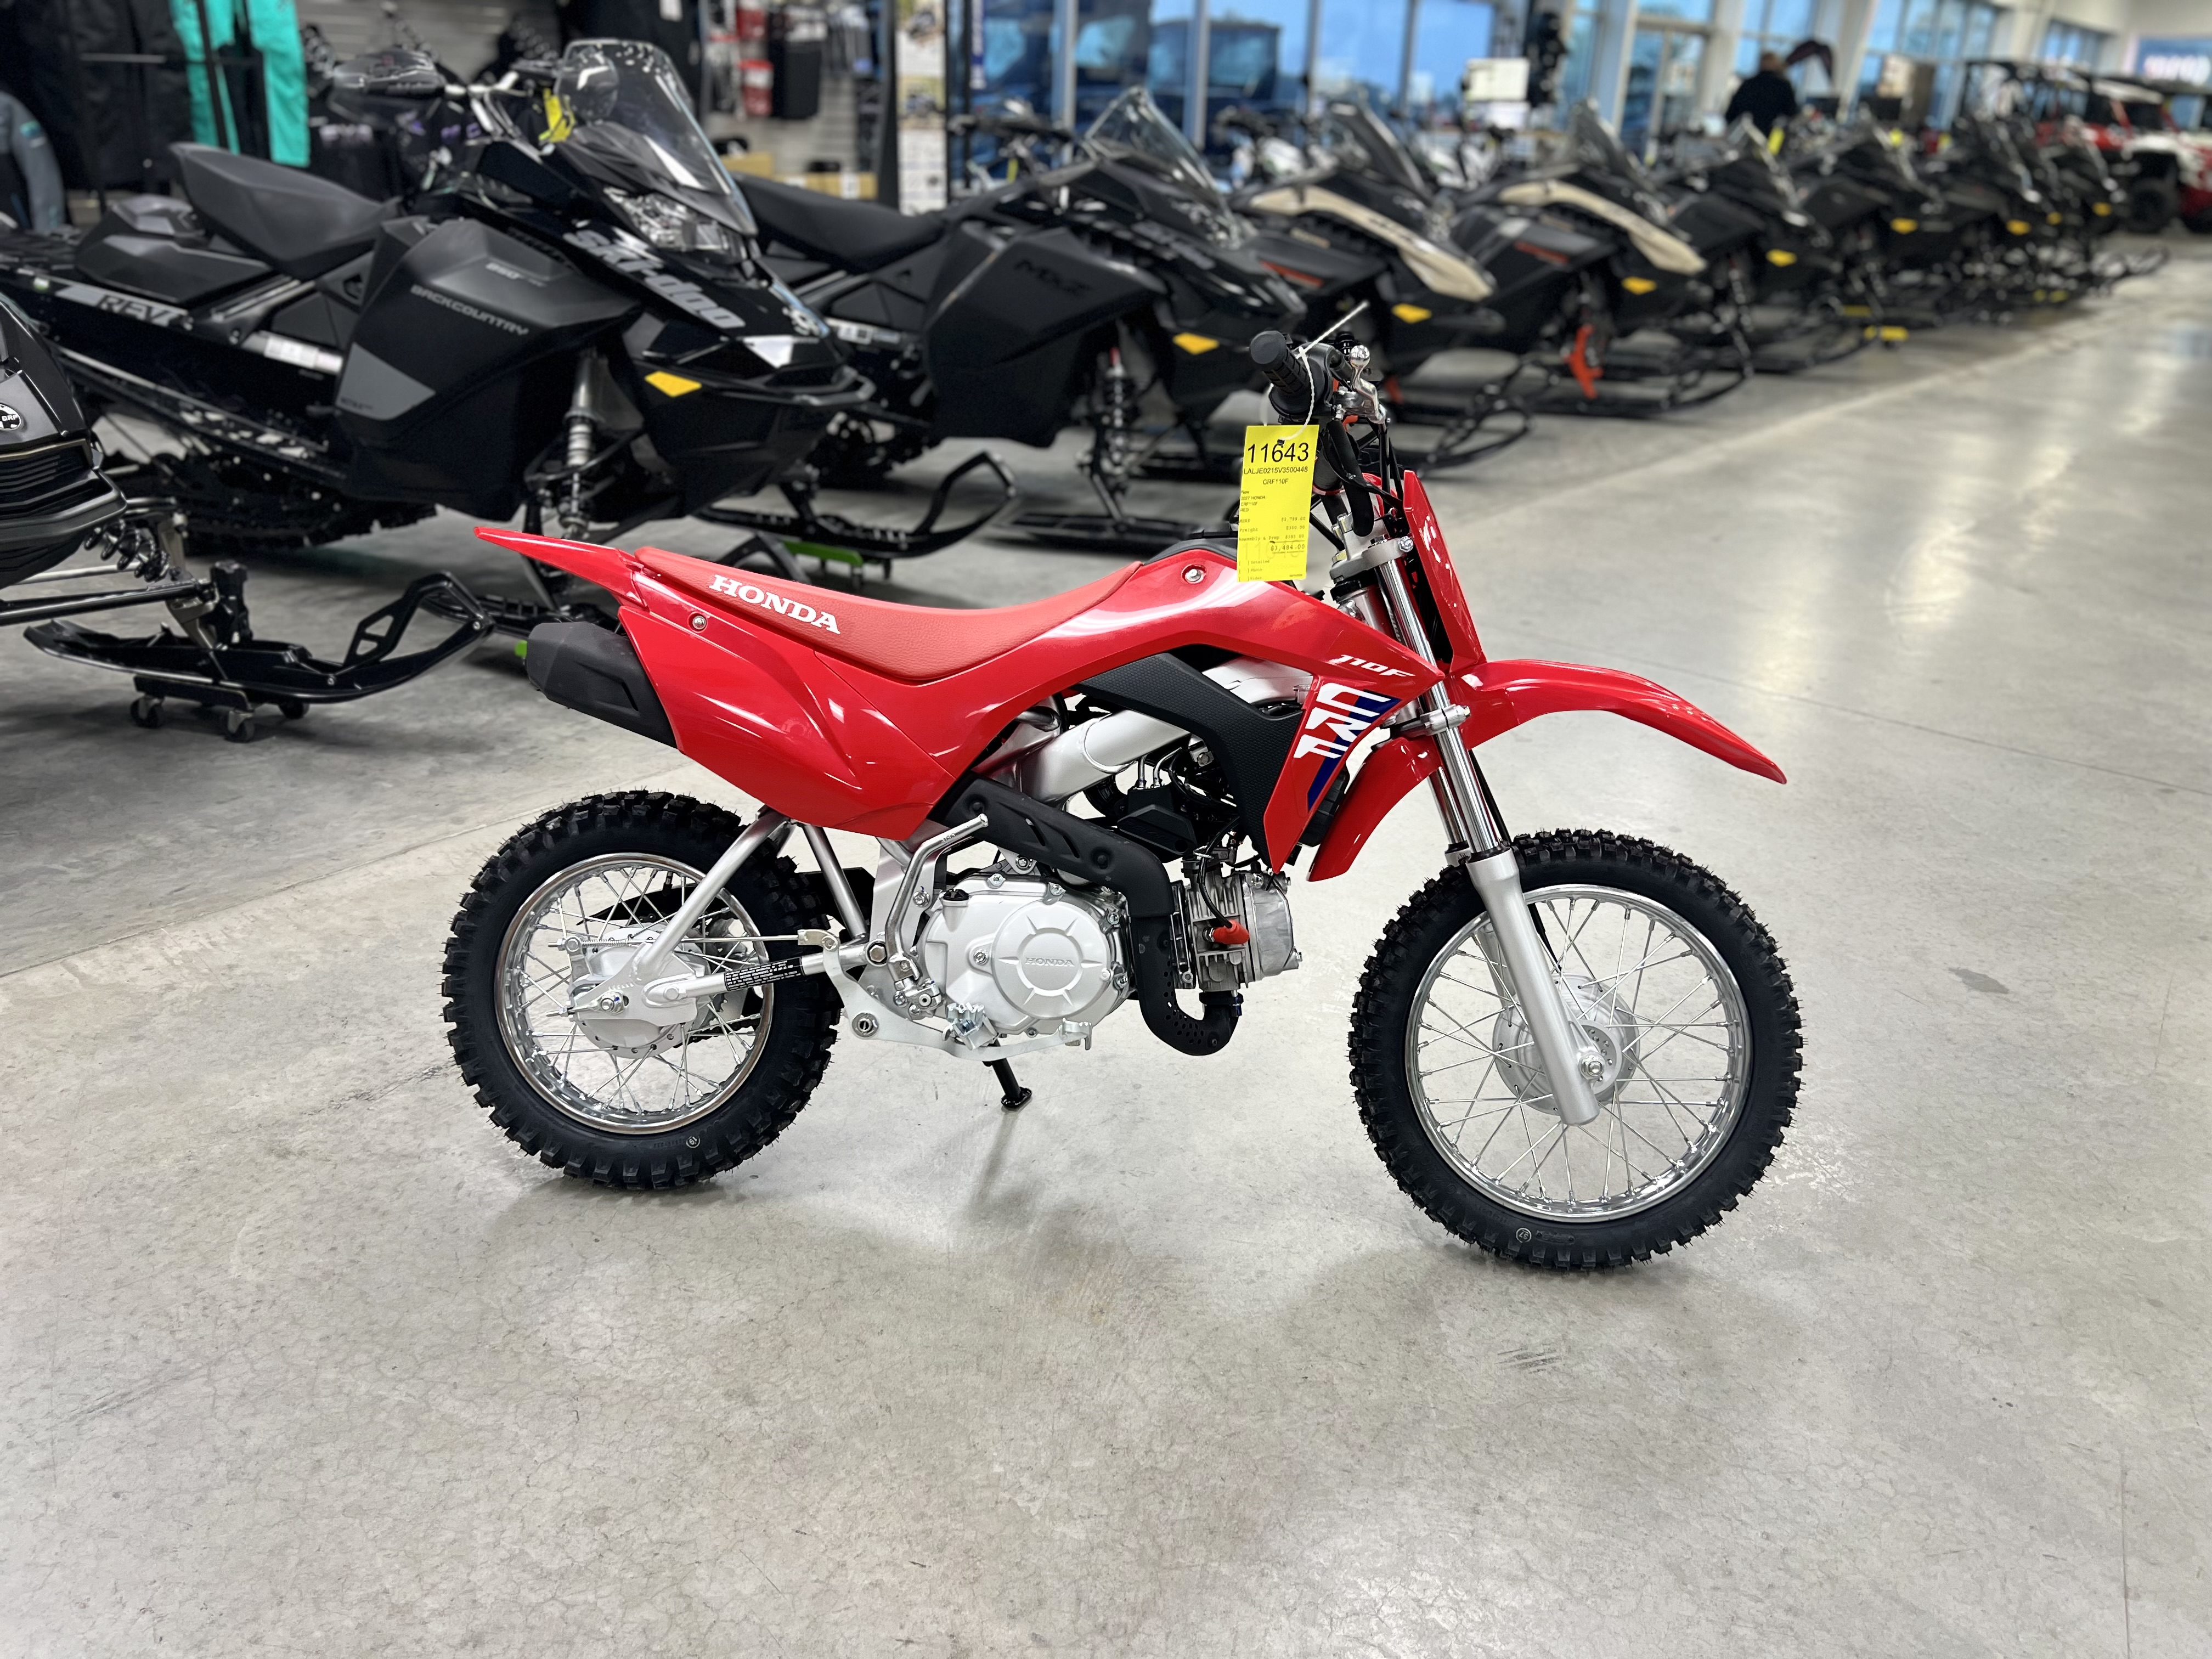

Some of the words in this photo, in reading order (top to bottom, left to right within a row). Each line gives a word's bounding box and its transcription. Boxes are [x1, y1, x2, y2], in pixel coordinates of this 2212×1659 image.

[410, 284, 529, 336] BACKCOUNTRY
[1248, 442, 1309, 463] 11643
[1244, 466, 1308, 475] LALJE0215V3500448
[708, 574, 841, 635] HONDA
[1328, 654, 1417, 677] 110F
[1293, 682, 1391, 759] CRF
[1025, 957, 1075, 967] HONDA
